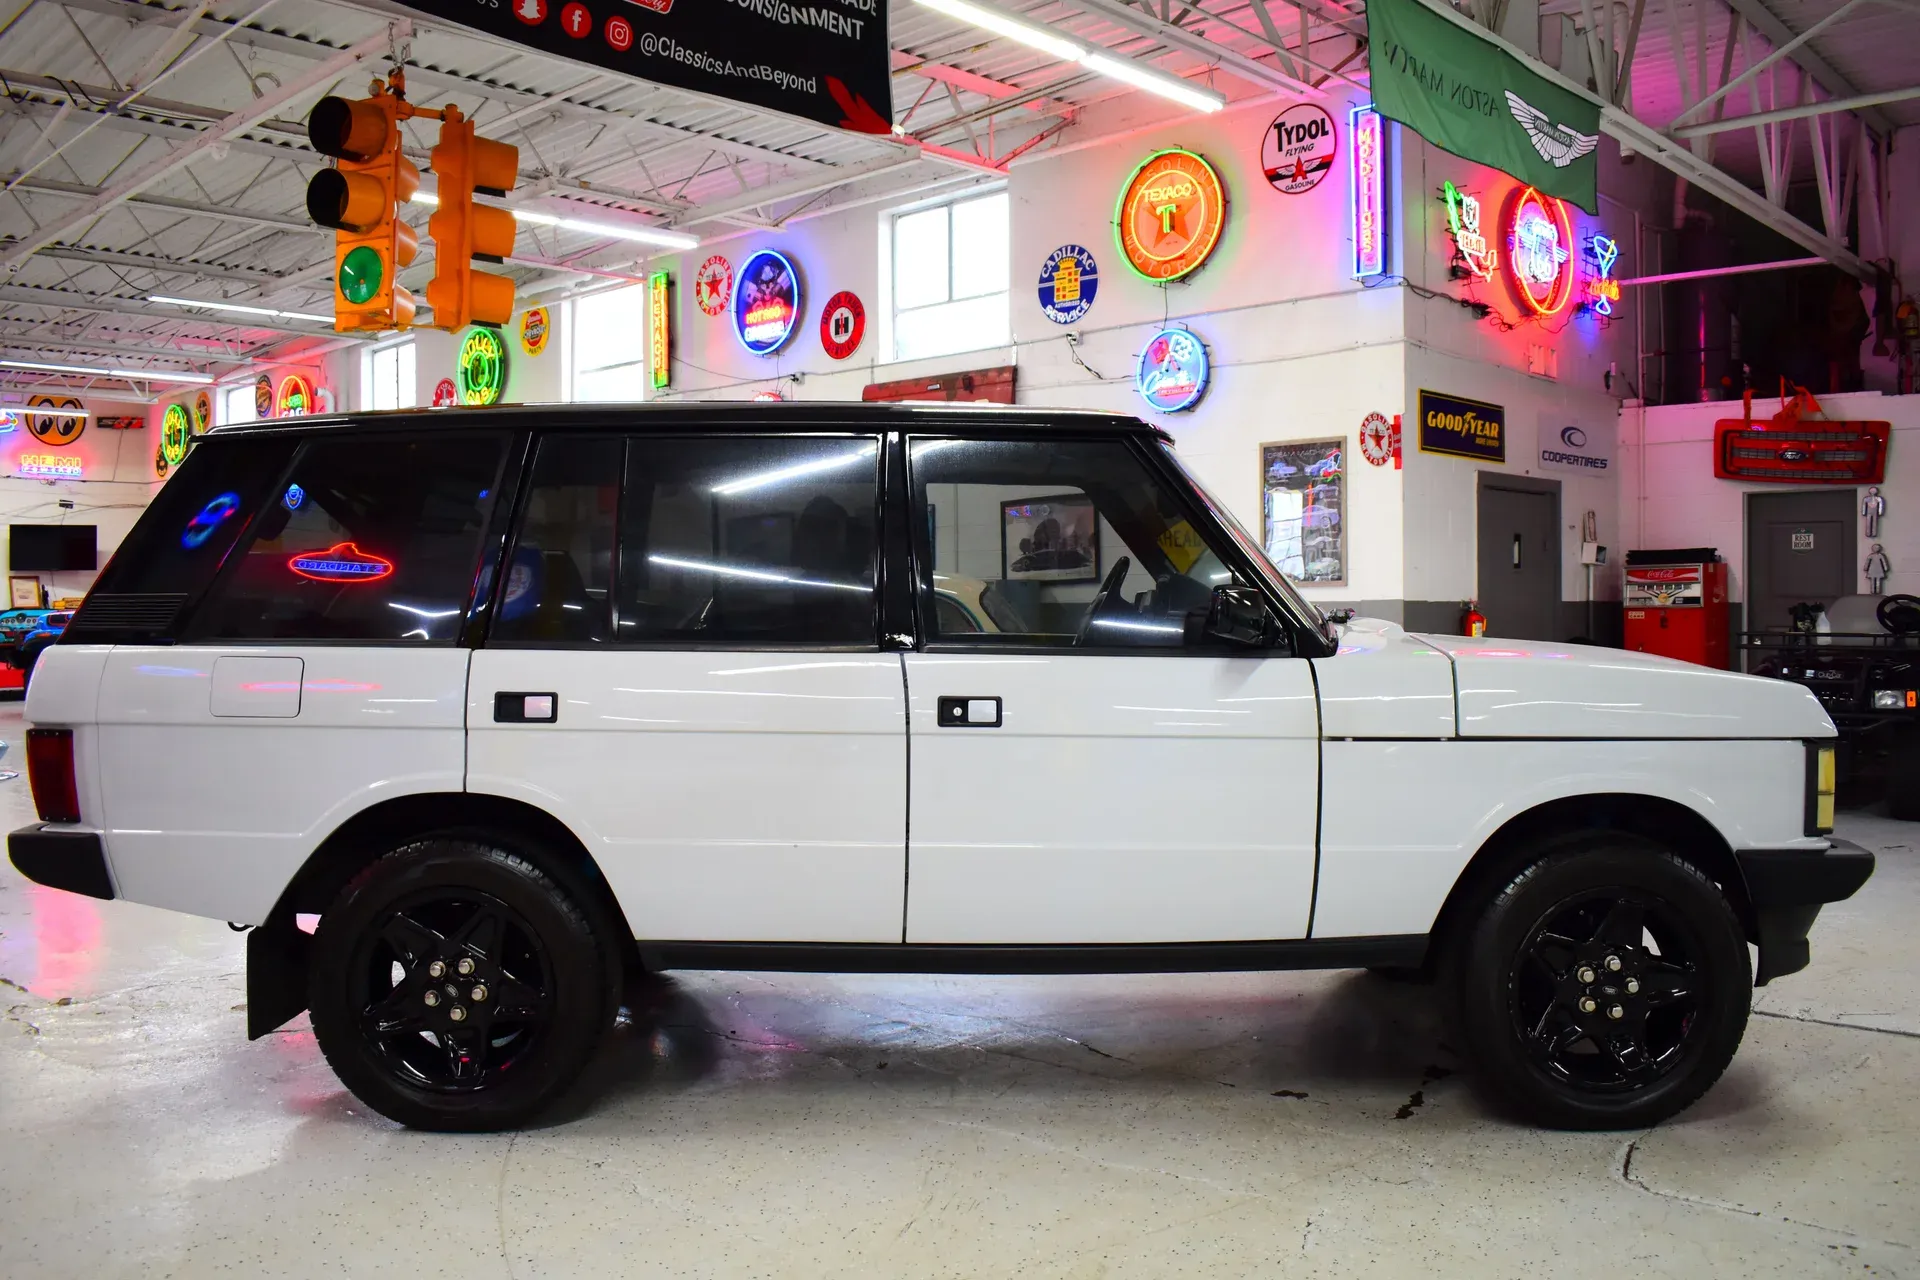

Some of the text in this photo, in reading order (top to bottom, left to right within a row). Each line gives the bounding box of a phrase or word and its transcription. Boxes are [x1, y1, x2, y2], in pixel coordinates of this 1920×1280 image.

[727, 0, 864, 40] NSIGNMENT
[640, 32, 816, 94] @ClassicsAndBeyond
[1274, 117, 1329, 152] TYDOL
[1285, 143, 1315, 157] FLYING
[1142, 182, 1192, 202] TEXACO
[1285, 179, 1315, 191] GASOLINE
[1042, 245, 1095, 278] CADILLAC
[1125, 233, 1187, 277] MOTOR
[1044, 298, 1090, 323] SERVICE
[653, 289, 663, 369] TEXACO
[466, 386, 490, 405] GAS
[21, 454, 82, 468] HEMI
[1361, 443, 1384, 464] MOTOR
[1793, 541, 1812, 549] ROOM
[1794, 534, 1811, 542] REST
